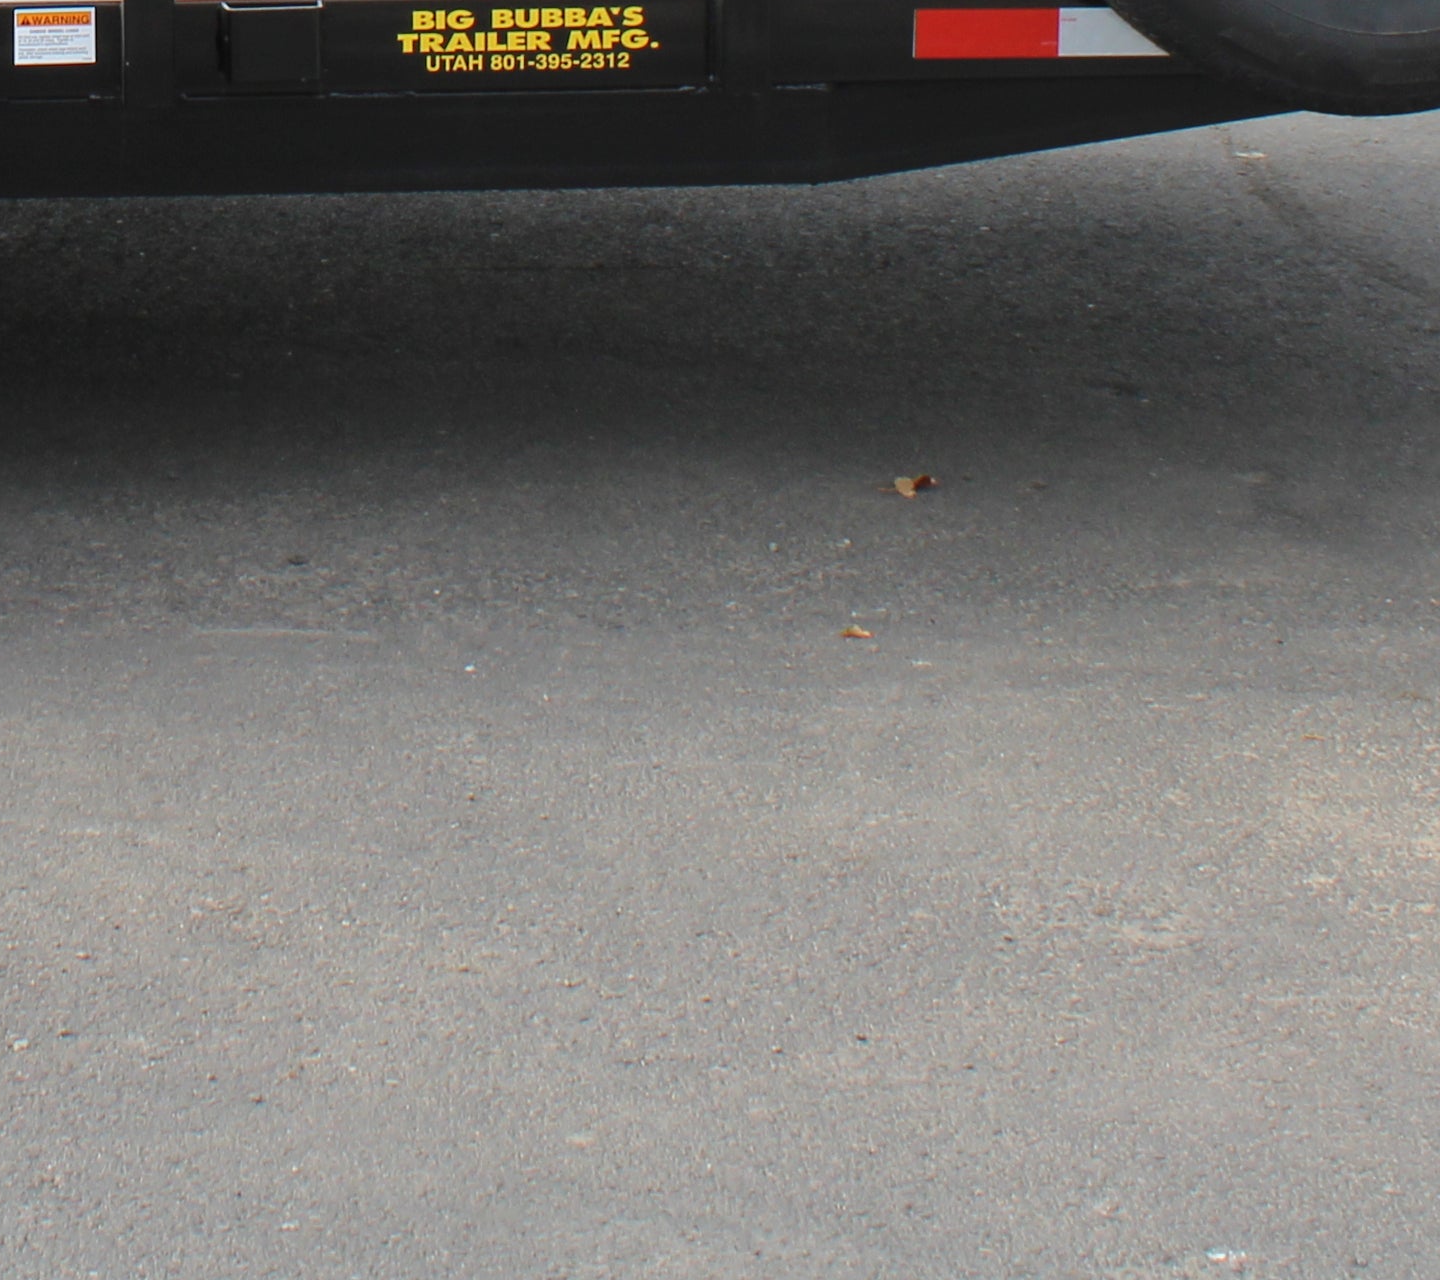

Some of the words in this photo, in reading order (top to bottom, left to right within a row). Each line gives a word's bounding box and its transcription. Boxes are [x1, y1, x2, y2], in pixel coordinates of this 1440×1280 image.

[31, 15, 90, 26] WARNING
[412, 10, 475, 30] BIG
[491, 6, 644, 29] BUBBA'S
[397, 32, 551, 53] TRAILER
[567, 29, 660, 50] MFG.
[426, 54, 483, 72] UTAH
[490, 52, 630, 71] 801-395-2312
